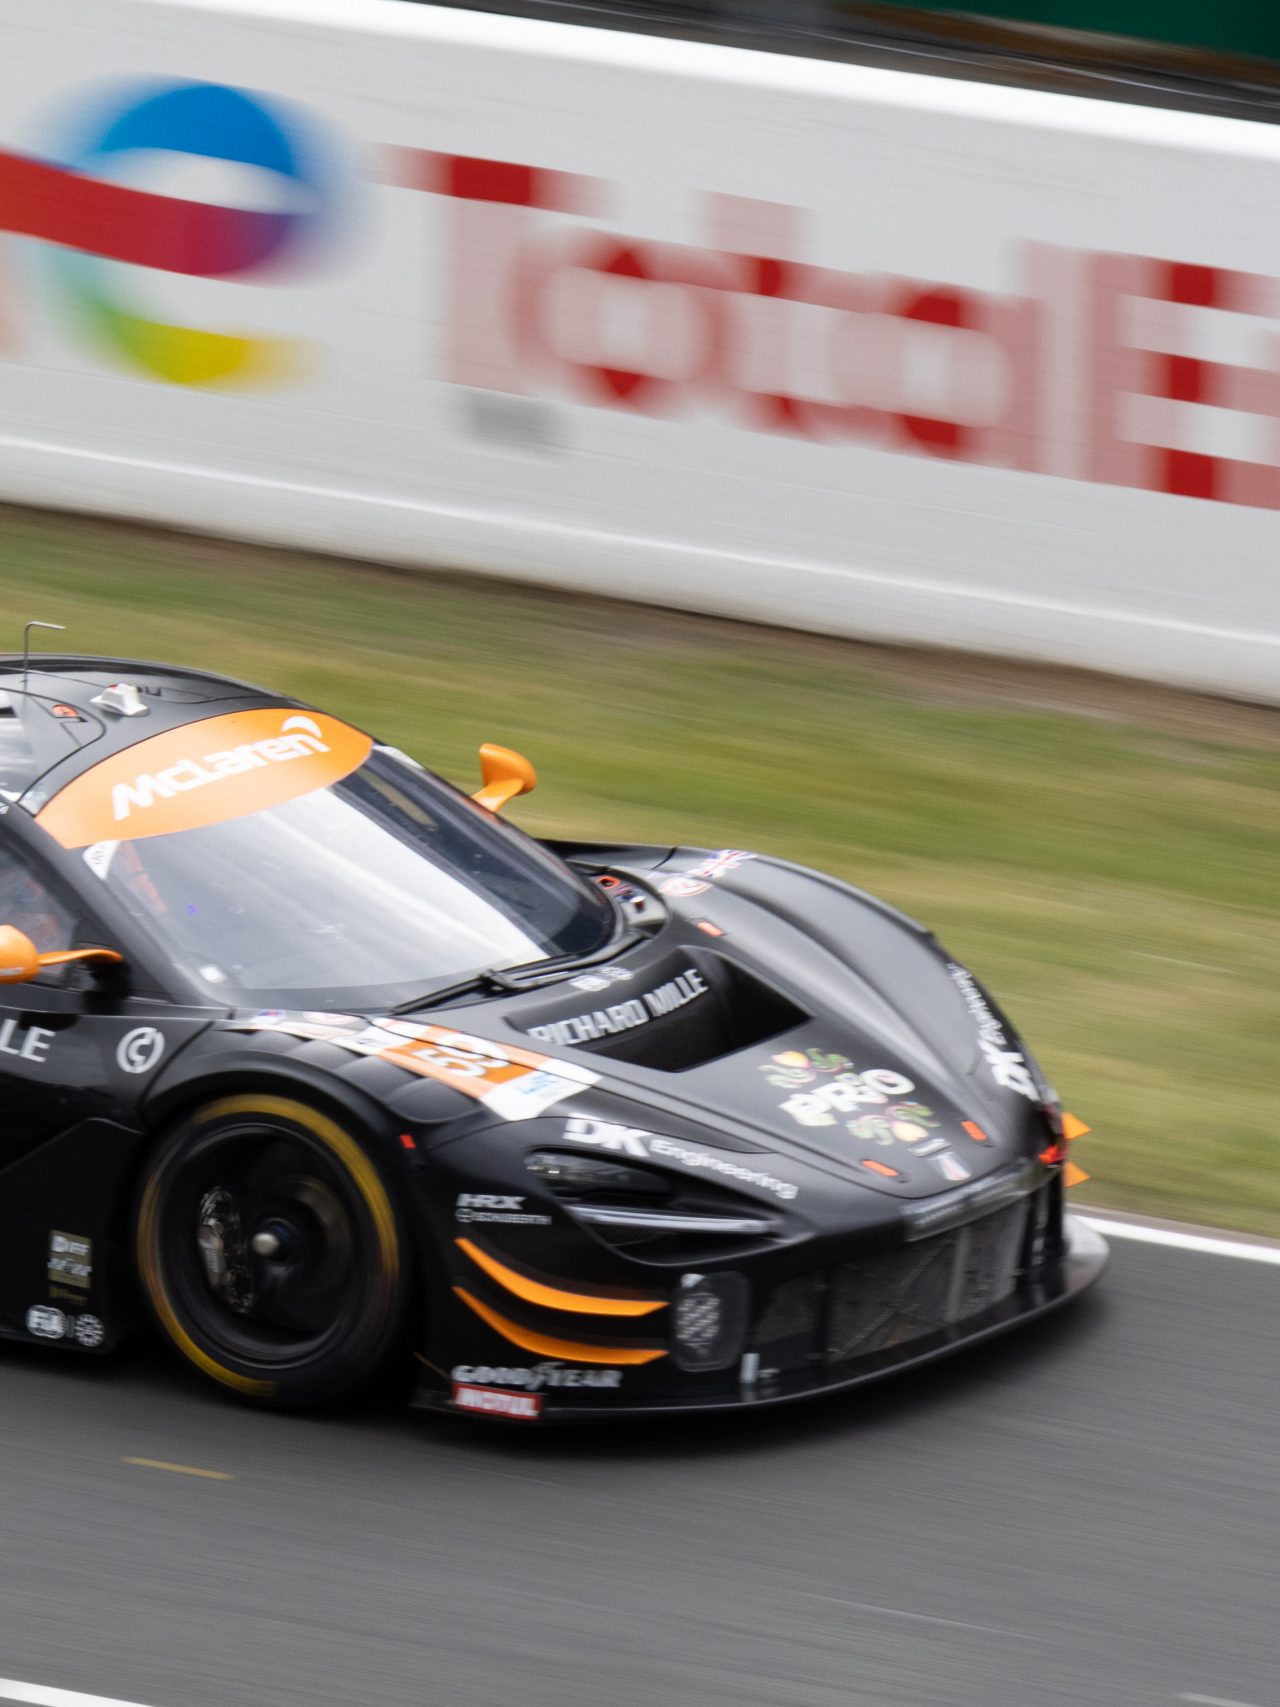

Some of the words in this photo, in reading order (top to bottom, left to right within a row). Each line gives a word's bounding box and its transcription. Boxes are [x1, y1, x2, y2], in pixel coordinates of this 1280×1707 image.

[111, 733, 331, 821] McLaren
[526, 998, 649, 1046] RICHARD
[642, 968, 709, 1017] MILLE
[562, 1112, 651, 1159] DK
[649, 1138, 800, 1200] Engineering
[451, 1361, 623, 1391] GOODYEAR
